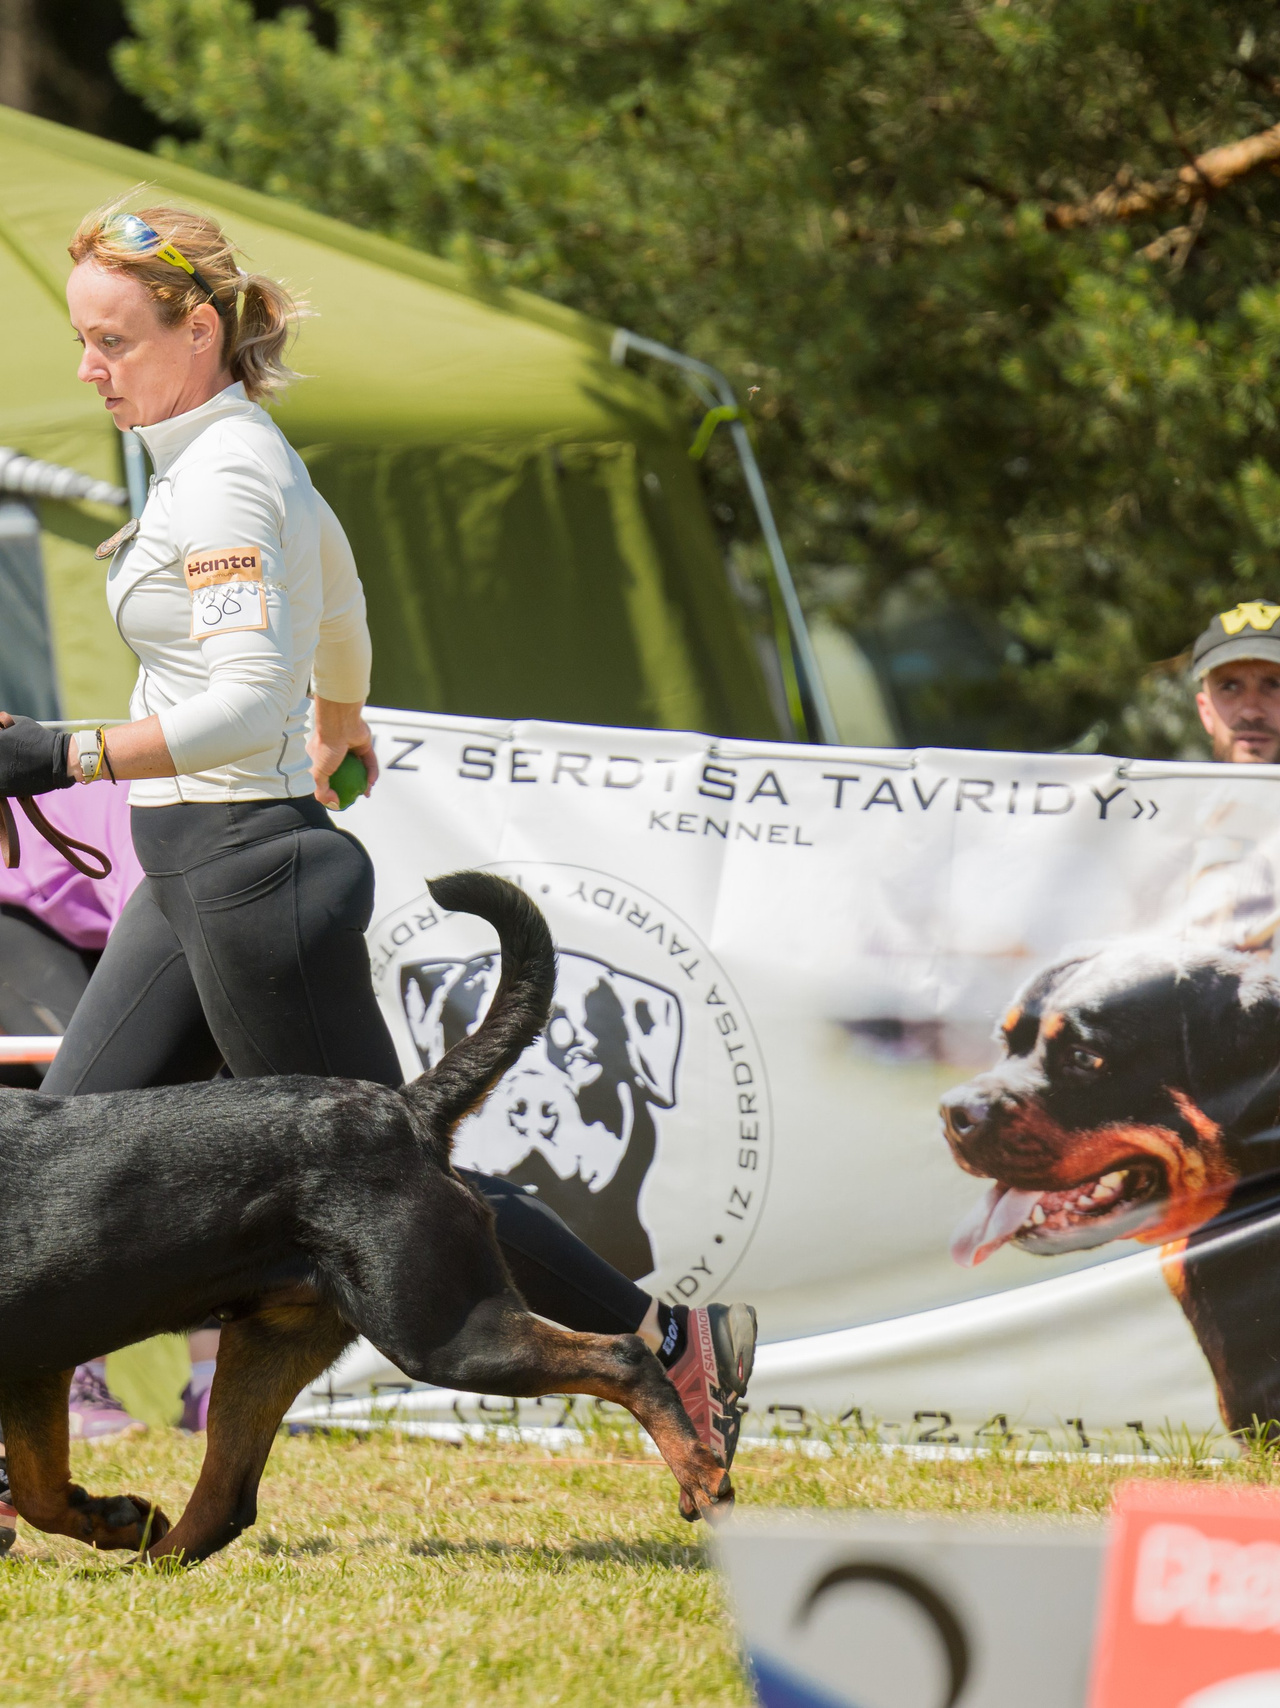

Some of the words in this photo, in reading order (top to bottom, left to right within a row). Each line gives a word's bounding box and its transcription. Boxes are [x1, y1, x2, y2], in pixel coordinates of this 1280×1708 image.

[202, 587, 241, 626] 38
[458, 744, 789, 806] SERDTSA
[648, 809, 814, 847] KENNEL
[566, 880, 707, 982] TAVRIDY
[704, 983, 760, 1172] SERDTSA
[725, 1184, 753, 1222] IZ
